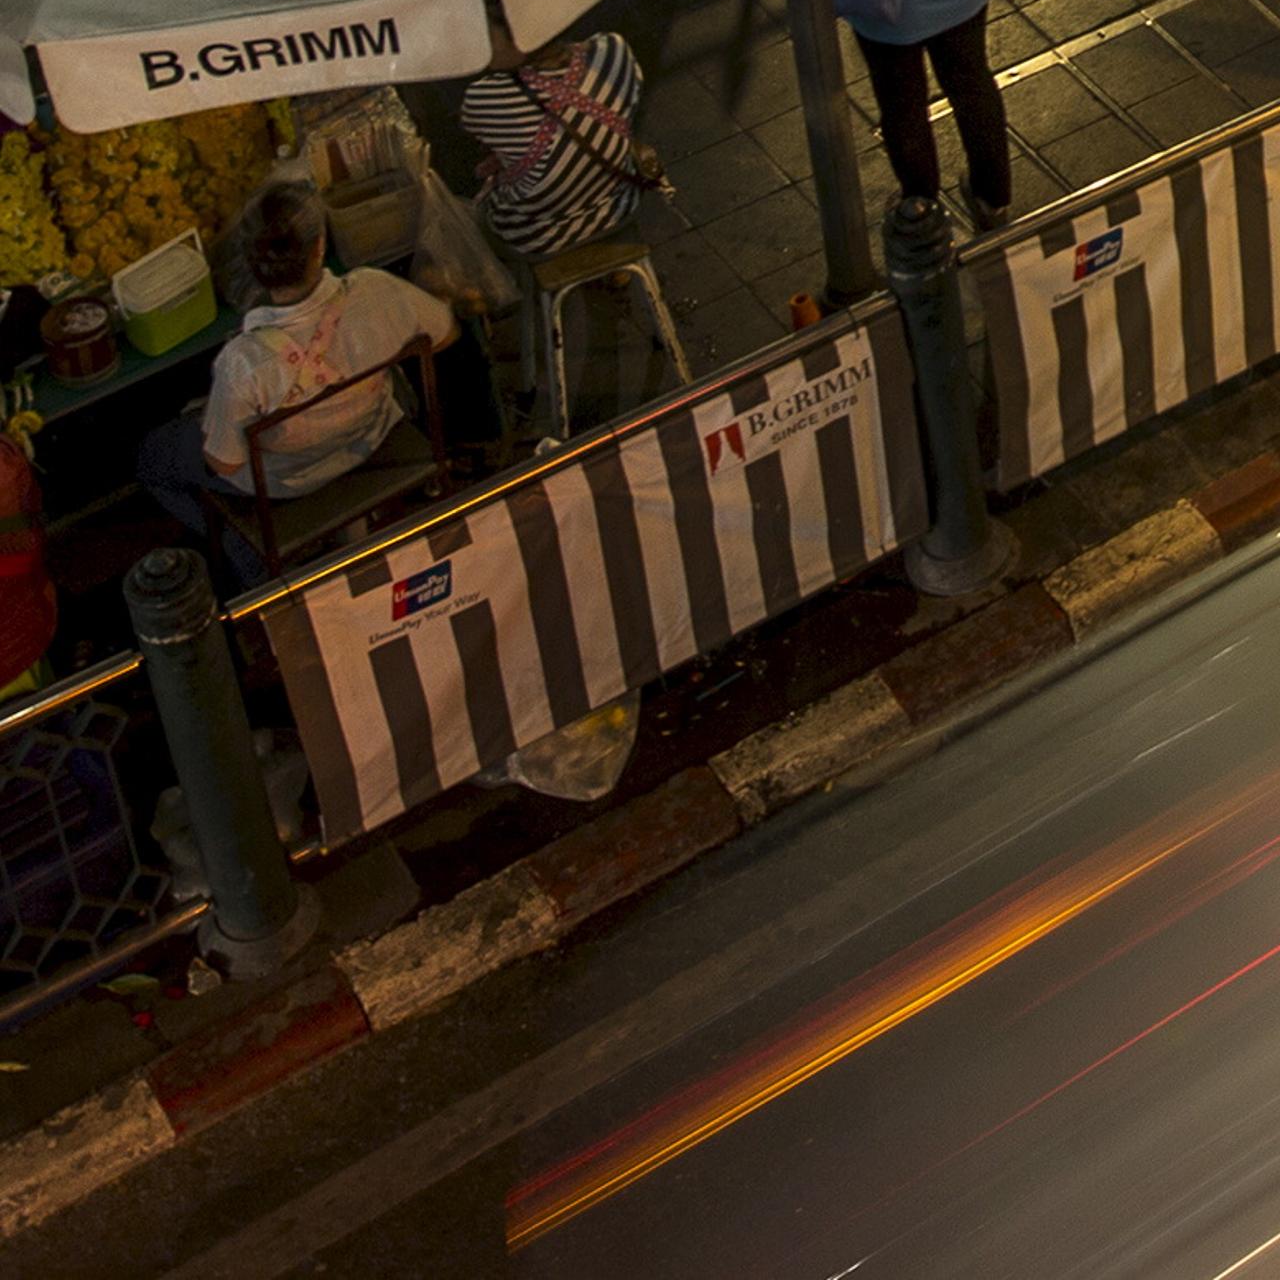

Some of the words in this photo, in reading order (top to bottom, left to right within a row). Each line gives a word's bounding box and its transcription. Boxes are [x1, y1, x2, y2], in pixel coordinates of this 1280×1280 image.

[140, 18, 401, 91] B.GRIMM
[747, 357, 873, 436] B.GRIMM
[771, 412, 819, 445] SINCE
